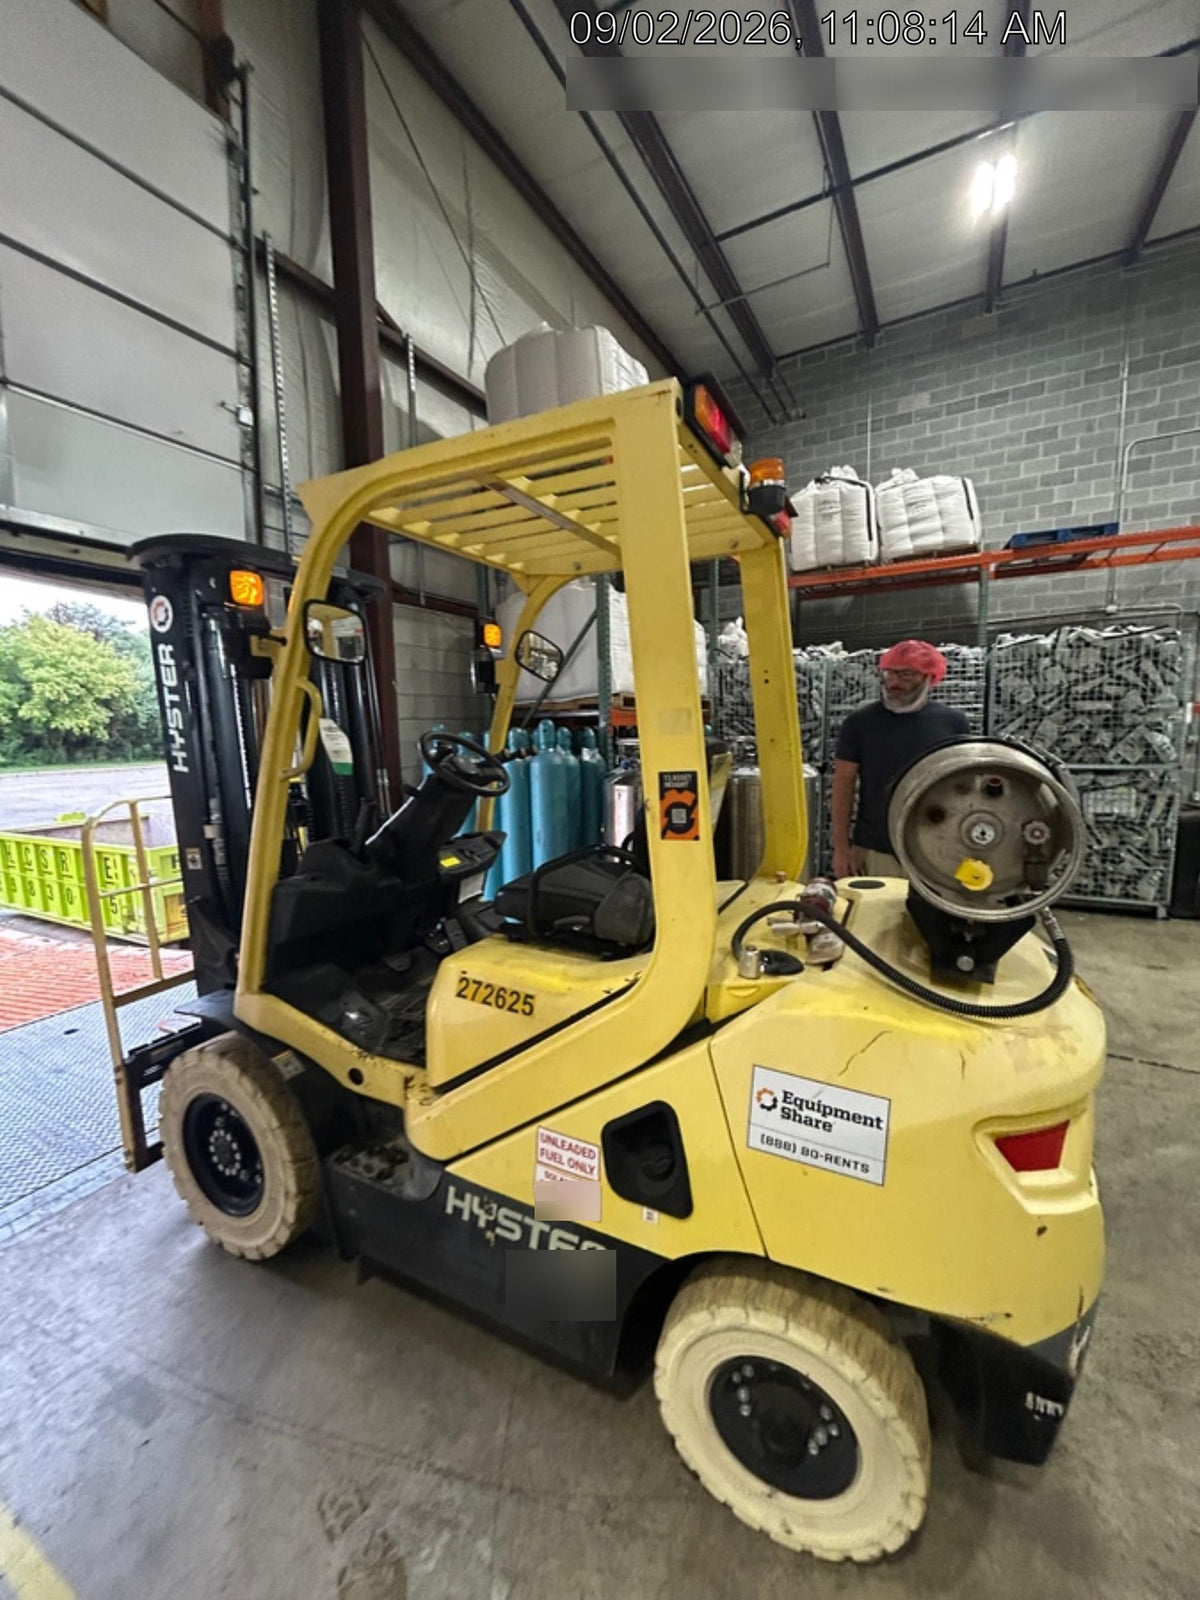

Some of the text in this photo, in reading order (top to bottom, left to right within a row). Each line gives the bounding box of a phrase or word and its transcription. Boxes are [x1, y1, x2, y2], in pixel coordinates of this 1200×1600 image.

[157, 642, 190, 773] HYSTER
[456, 977, 535, 1016] 272625
[780, 1105, 834, 1133] Share
[781, 1089, 884, 1131] Equipment
[540, 1132, 597, 1160] UNLEADED
[760, 1133, 798, 1154] (888)
[540, 1147, 566, 1166] FUEL
[567, 1157, 596, 1176] ONLY
